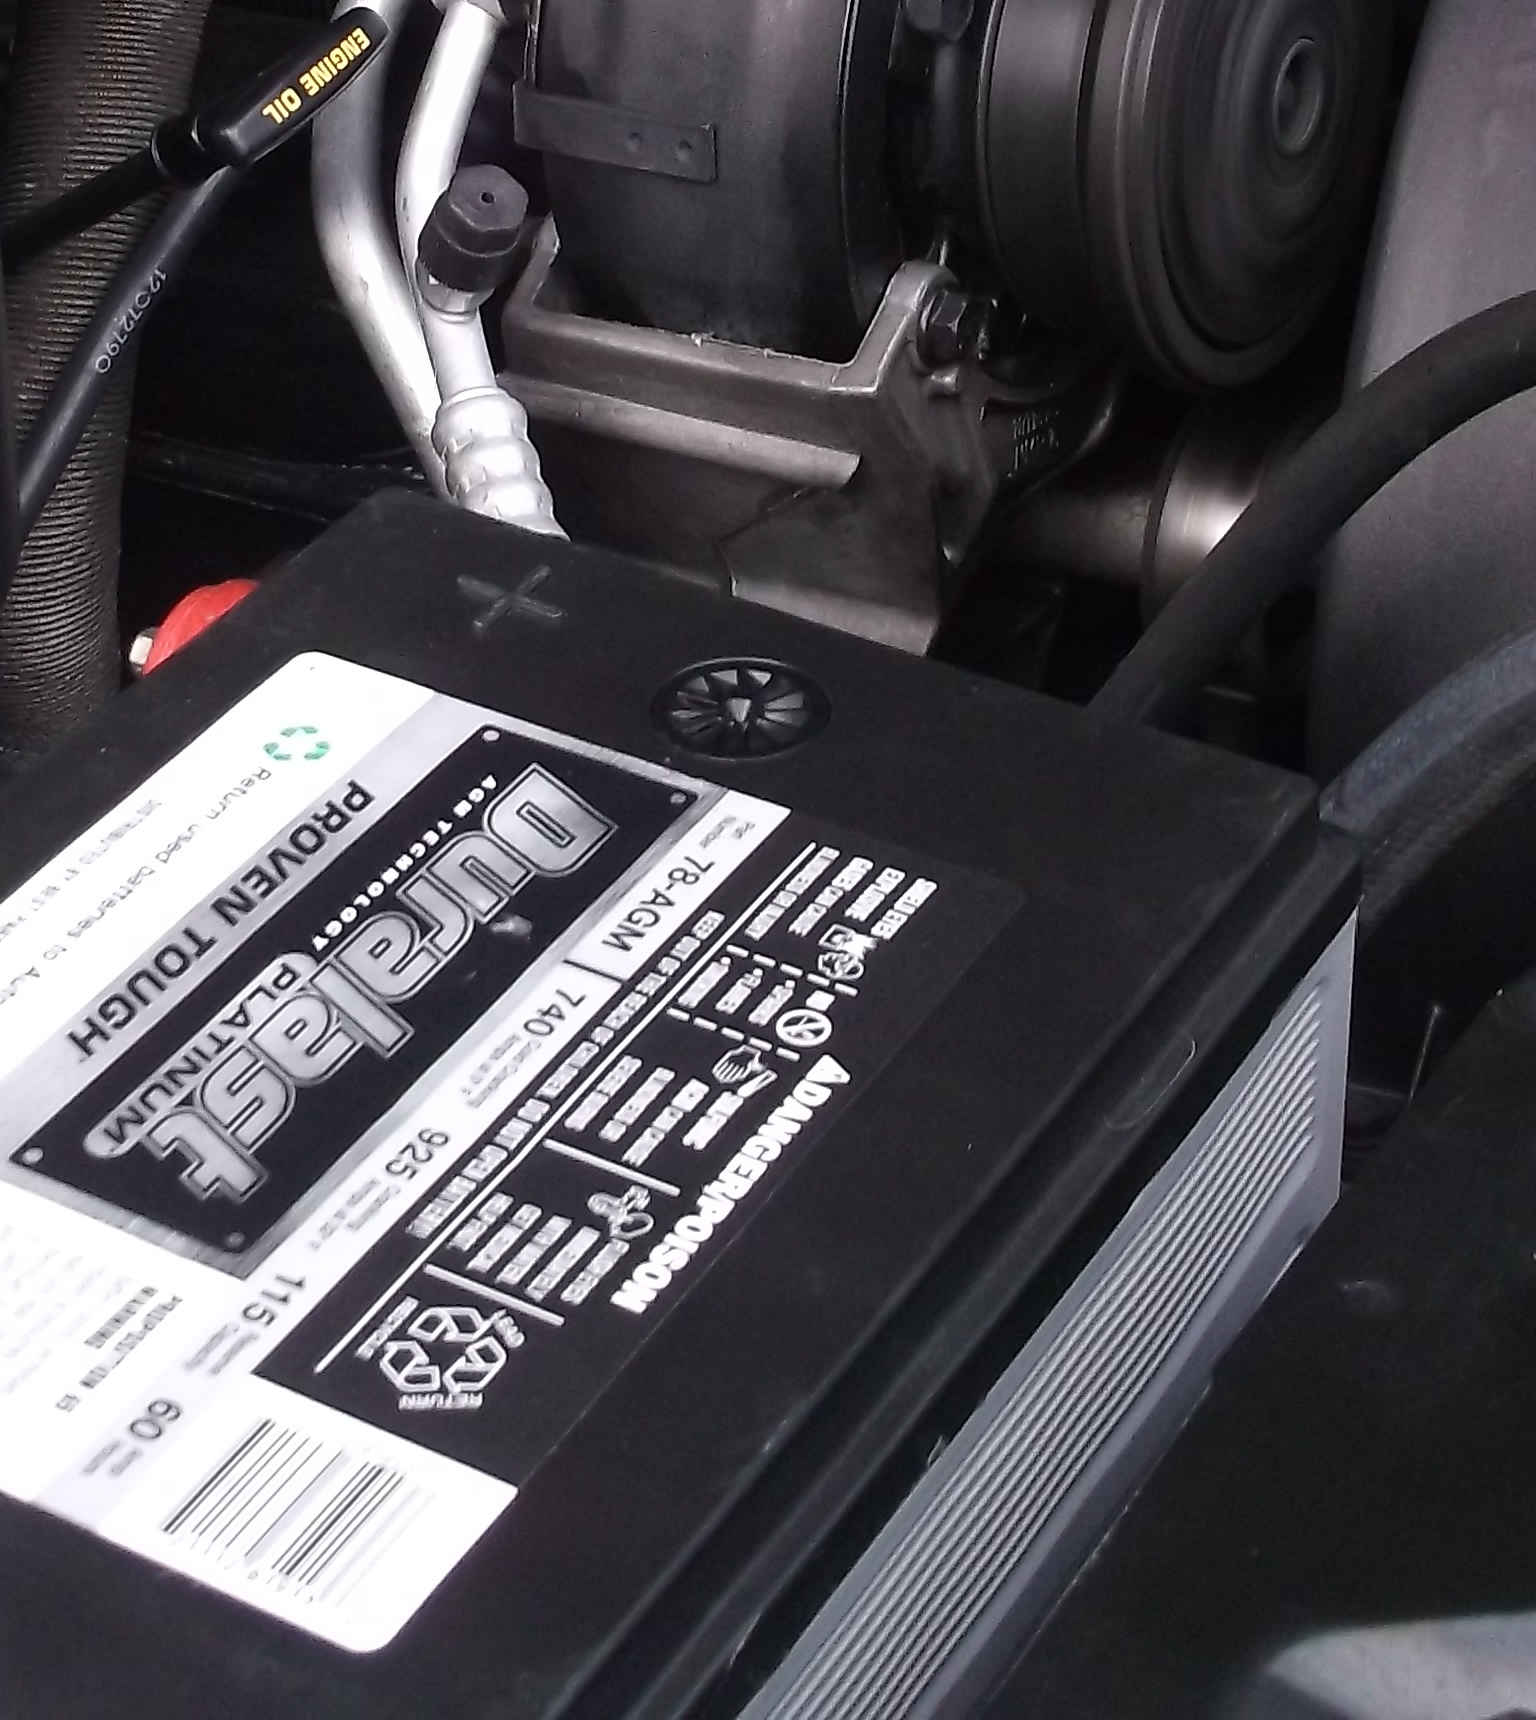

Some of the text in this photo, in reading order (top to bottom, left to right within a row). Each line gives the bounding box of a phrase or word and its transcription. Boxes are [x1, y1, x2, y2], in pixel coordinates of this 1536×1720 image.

[261, 27, 371, 124] ENGINE OIL
[95, 269, 167, 373] 12072790
[206, 766, 271, 819] Return
[154, 824, 198, 863] used
[312, 821, 451, 950] TECHNOLOGY
[67, 780, 374, 1058] PROVEN TOUGH
[601, 856, 714, 951] 78-AGM
[179, 763, 618, 1202] Duralast
[523, 989, 585, 1036] 740
[98, 962, 300, 1147] PLATINUM
[385, 1128, 449, 1179] 925
[611, 1079, 830, 1312] DANGER/POISON
[241, 1275, 305, 1326] 115
[127, 1399, 182, 1440] 60
